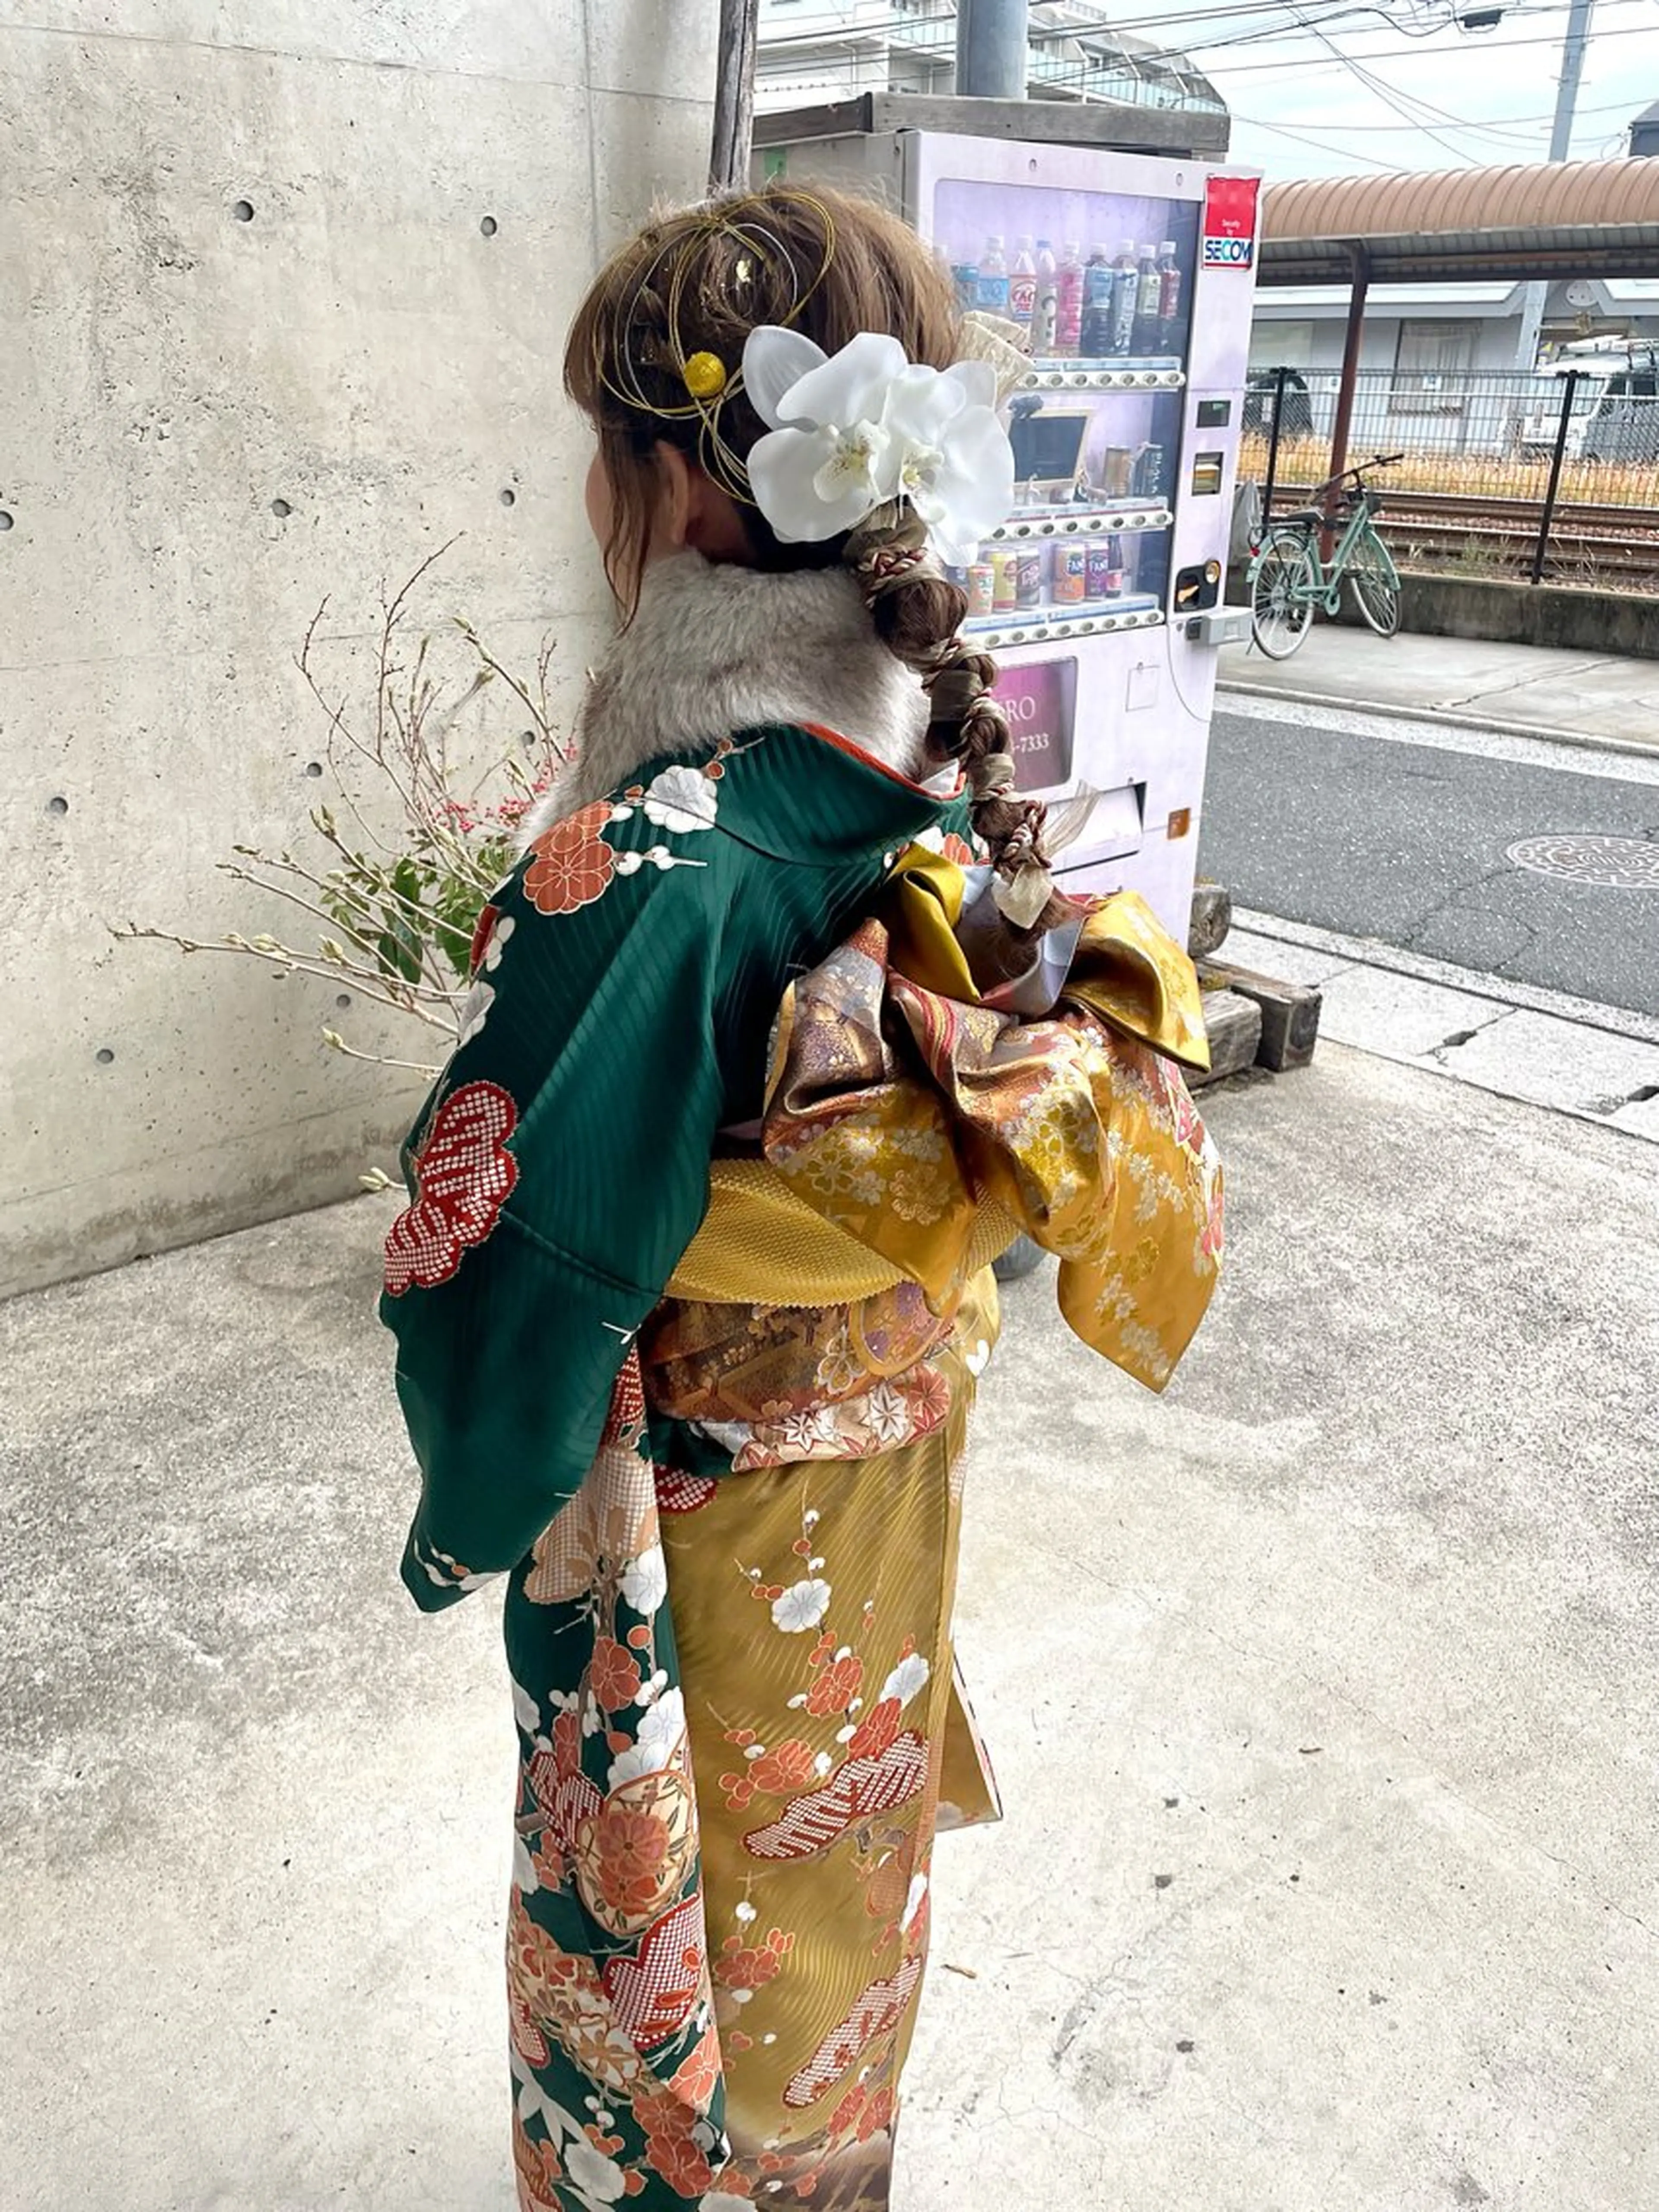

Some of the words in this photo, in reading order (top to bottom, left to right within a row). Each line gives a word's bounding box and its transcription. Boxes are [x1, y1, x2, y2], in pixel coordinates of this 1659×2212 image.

[1205, 239, 1253, 261] SECOM
[999, 696, 1036, 722] RO
[1013, 732, 1049, 753] -7333
